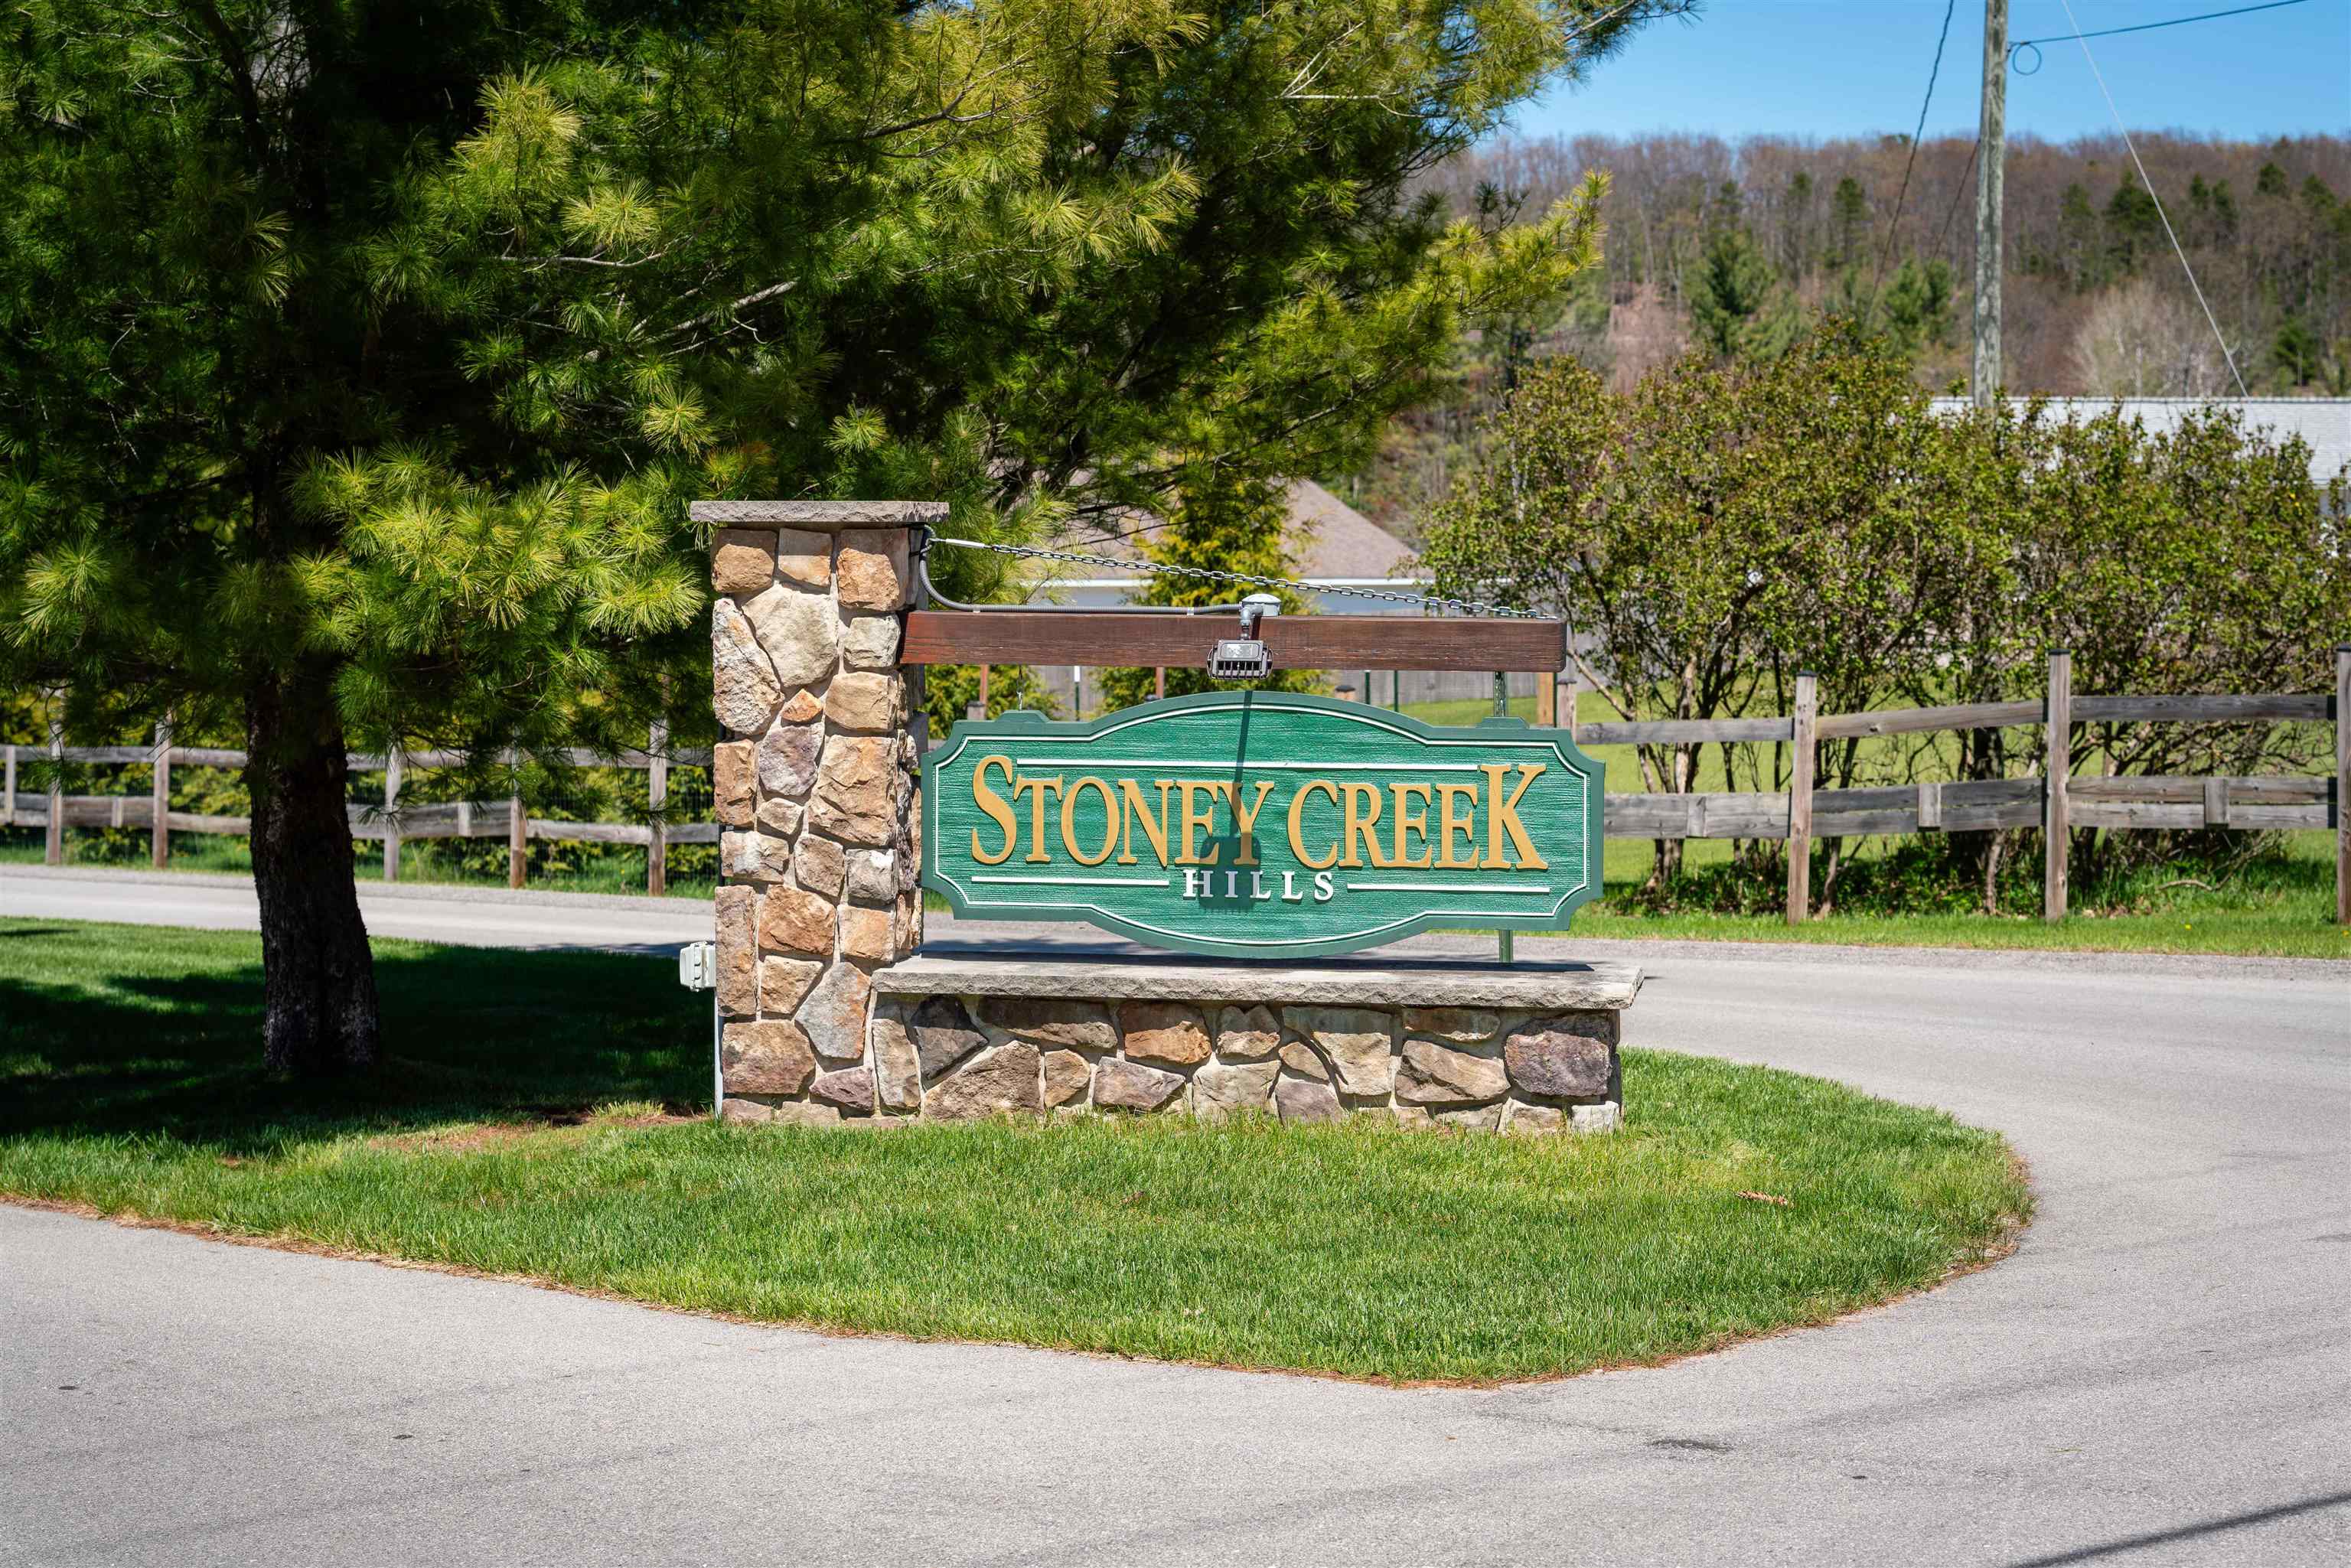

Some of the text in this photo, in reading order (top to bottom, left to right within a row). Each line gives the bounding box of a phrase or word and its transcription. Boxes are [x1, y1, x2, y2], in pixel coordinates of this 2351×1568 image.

[971, 755, 1549, 870] STONEY CREEK
[1182, 869, 1335, 901] HILLS
